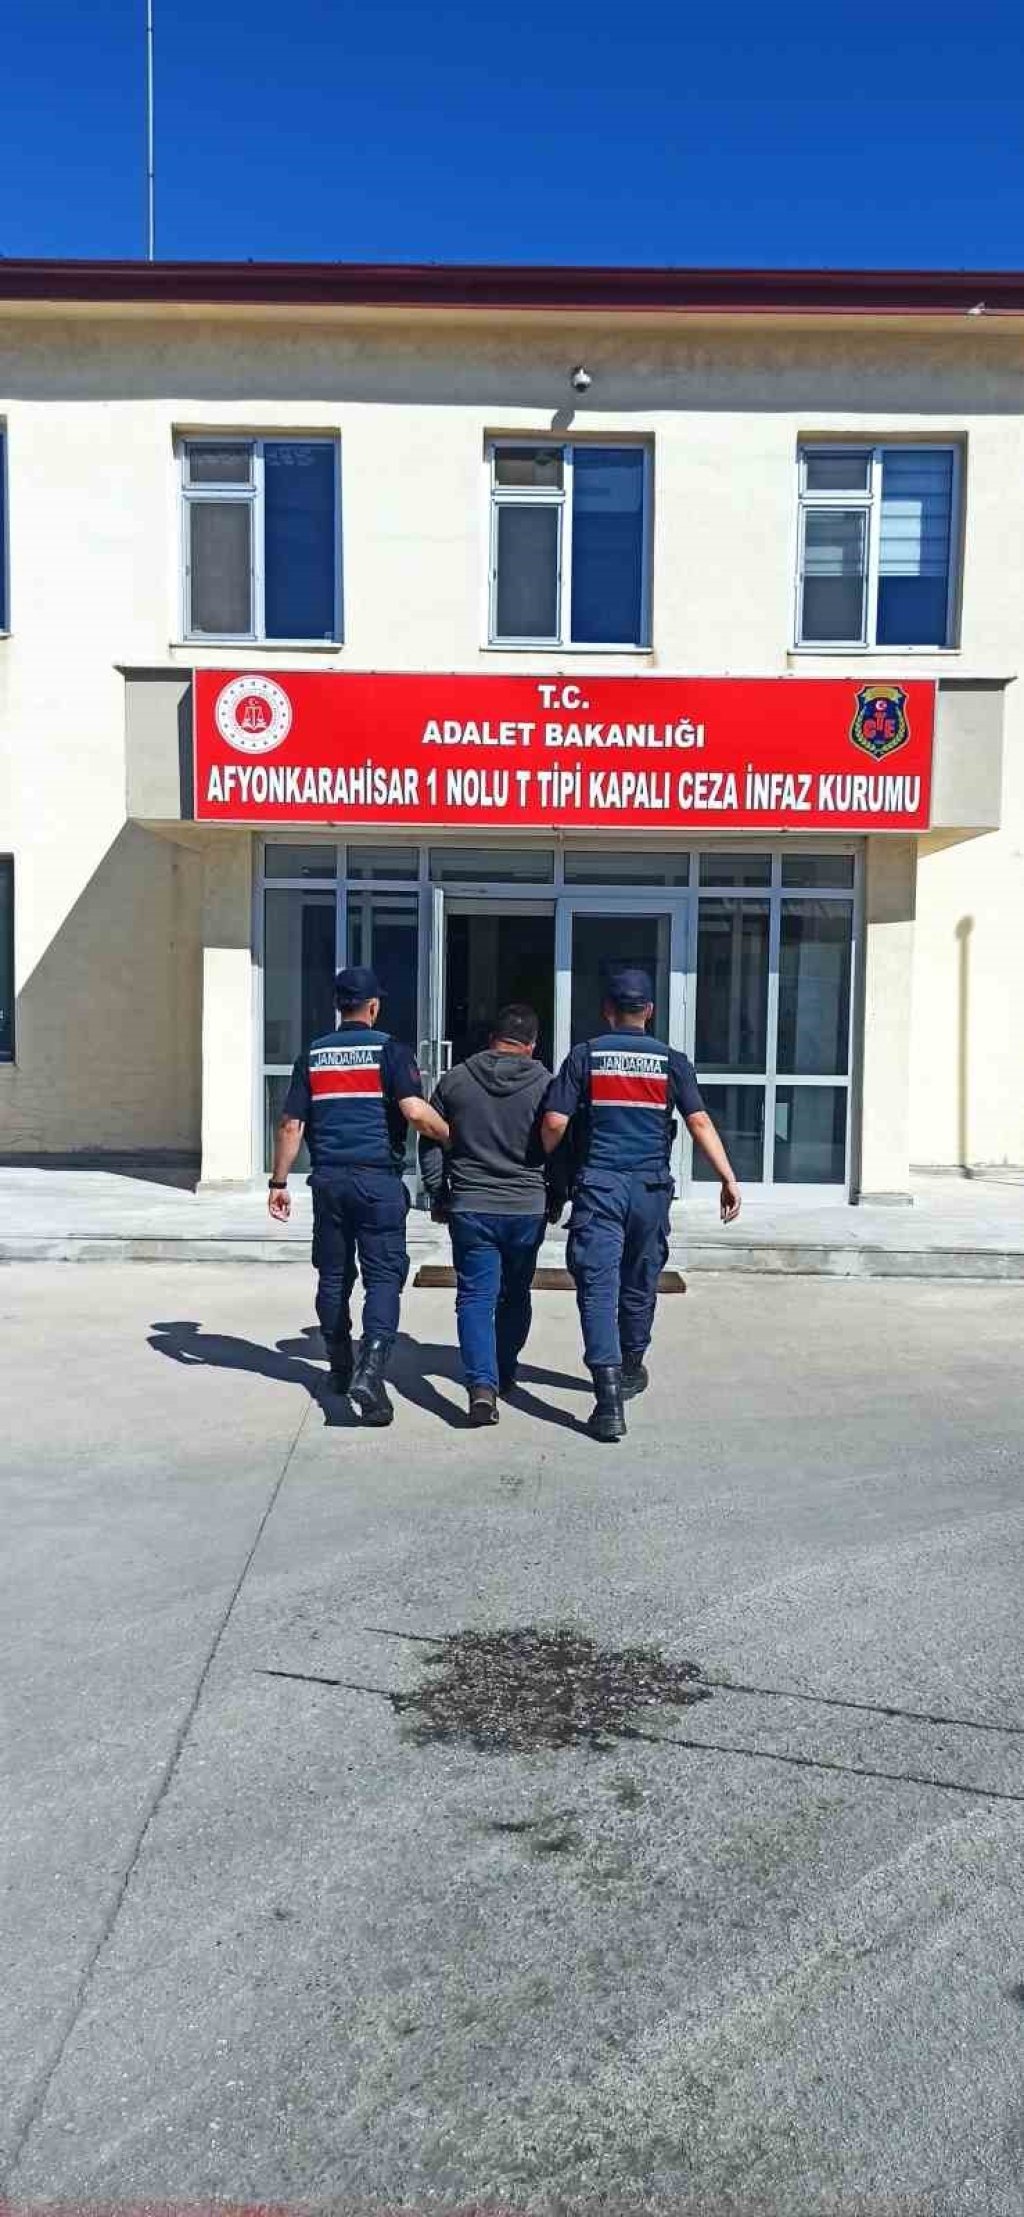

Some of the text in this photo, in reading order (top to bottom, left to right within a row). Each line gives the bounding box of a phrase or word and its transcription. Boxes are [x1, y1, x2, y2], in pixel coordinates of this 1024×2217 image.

[537, 685, 590, 709] T.C.
[422, 718, 705, 748] ADALET BAKANLIĞI
[207, 758, 921, 813] AFYONKARAHİSAR 1 NOLU T TİPİ KAPALI CEZA İNFAZ KURUMU
[314, 1050, 374, 1067] JANDARMA
[600, 1055, 662, 1073] JANDARMA
